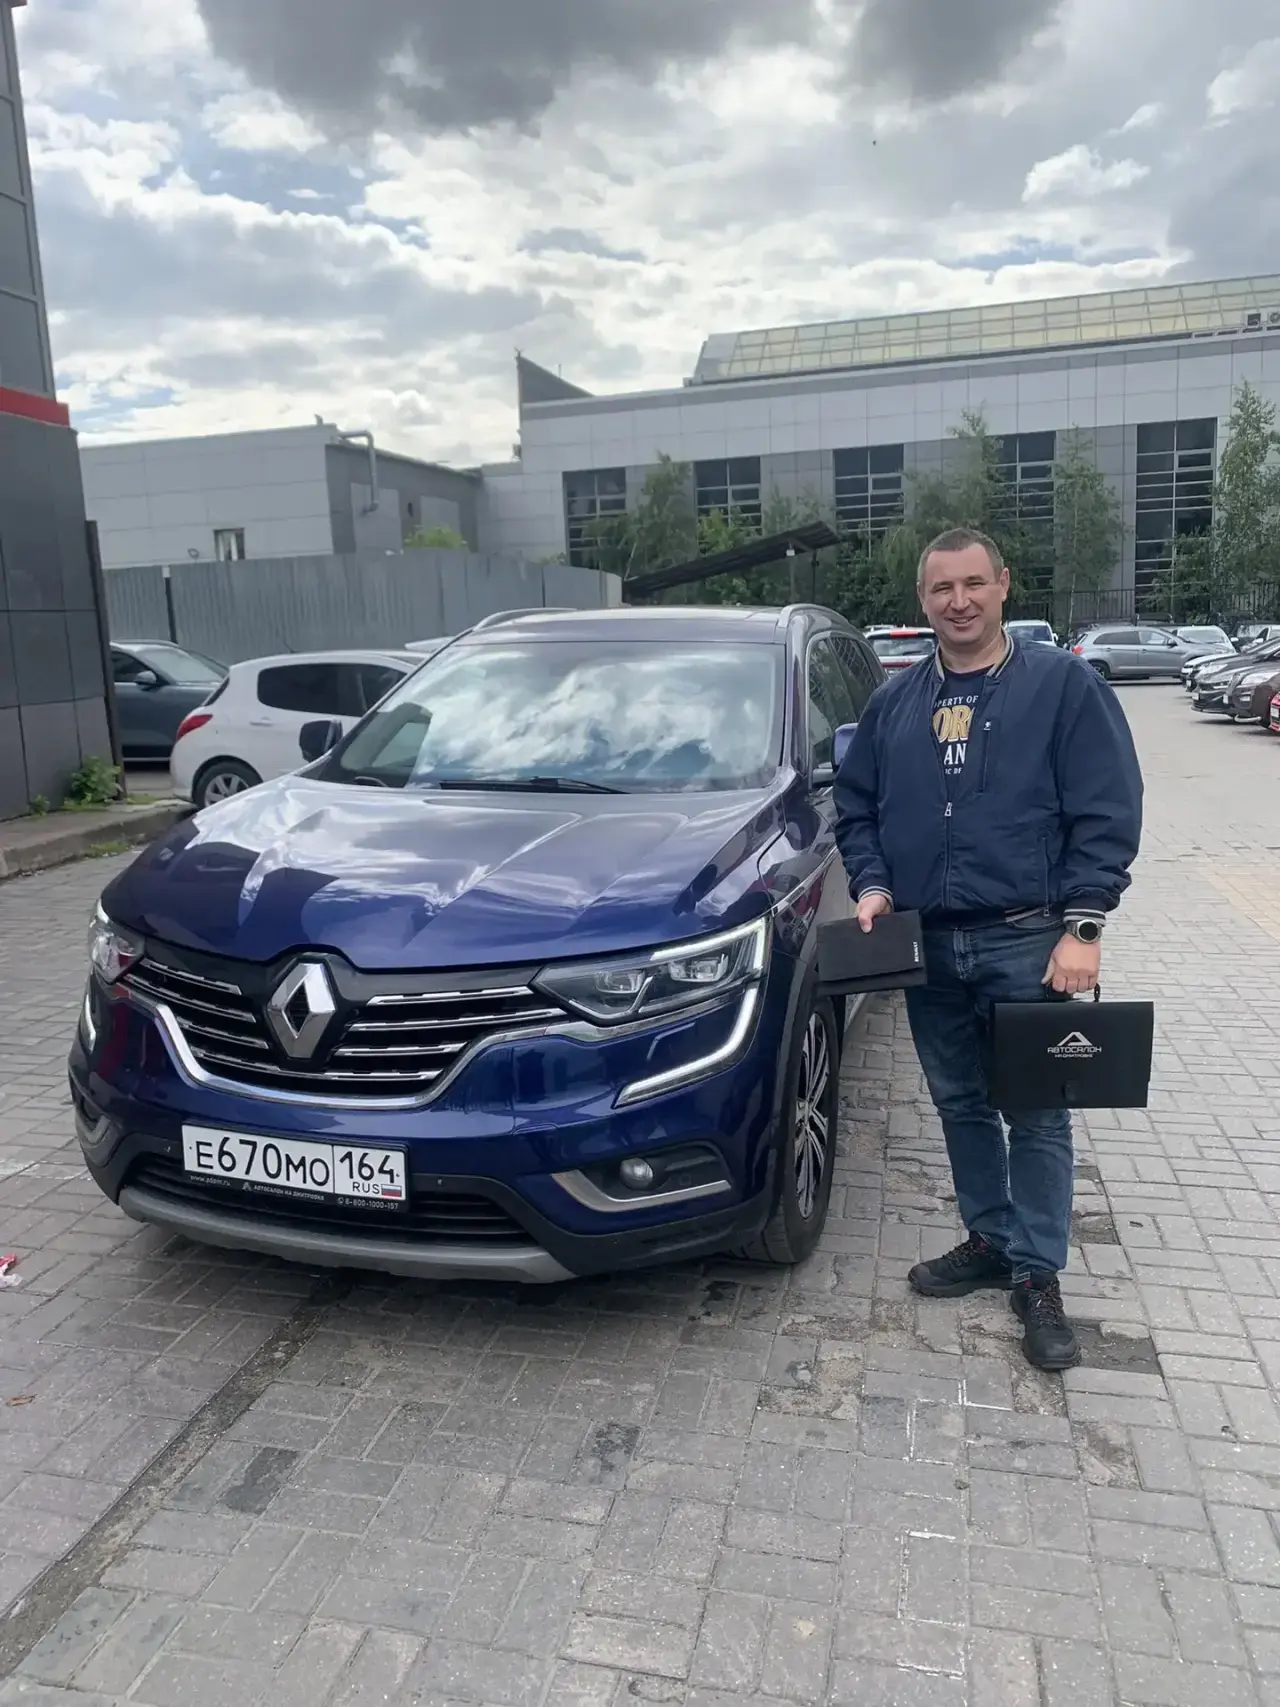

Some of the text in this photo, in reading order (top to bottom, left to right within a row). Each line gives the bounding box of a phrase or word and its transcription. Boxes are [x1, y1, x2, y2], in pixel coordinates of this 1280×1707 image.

[966, 695, 979, 704] OF
[932, 705, 975, 743] OR
[196, 1137, 329, 1186] Е670МО
[339, 1151, 395, 1184] 164
[353, 1181, 380, 1194] RUS
